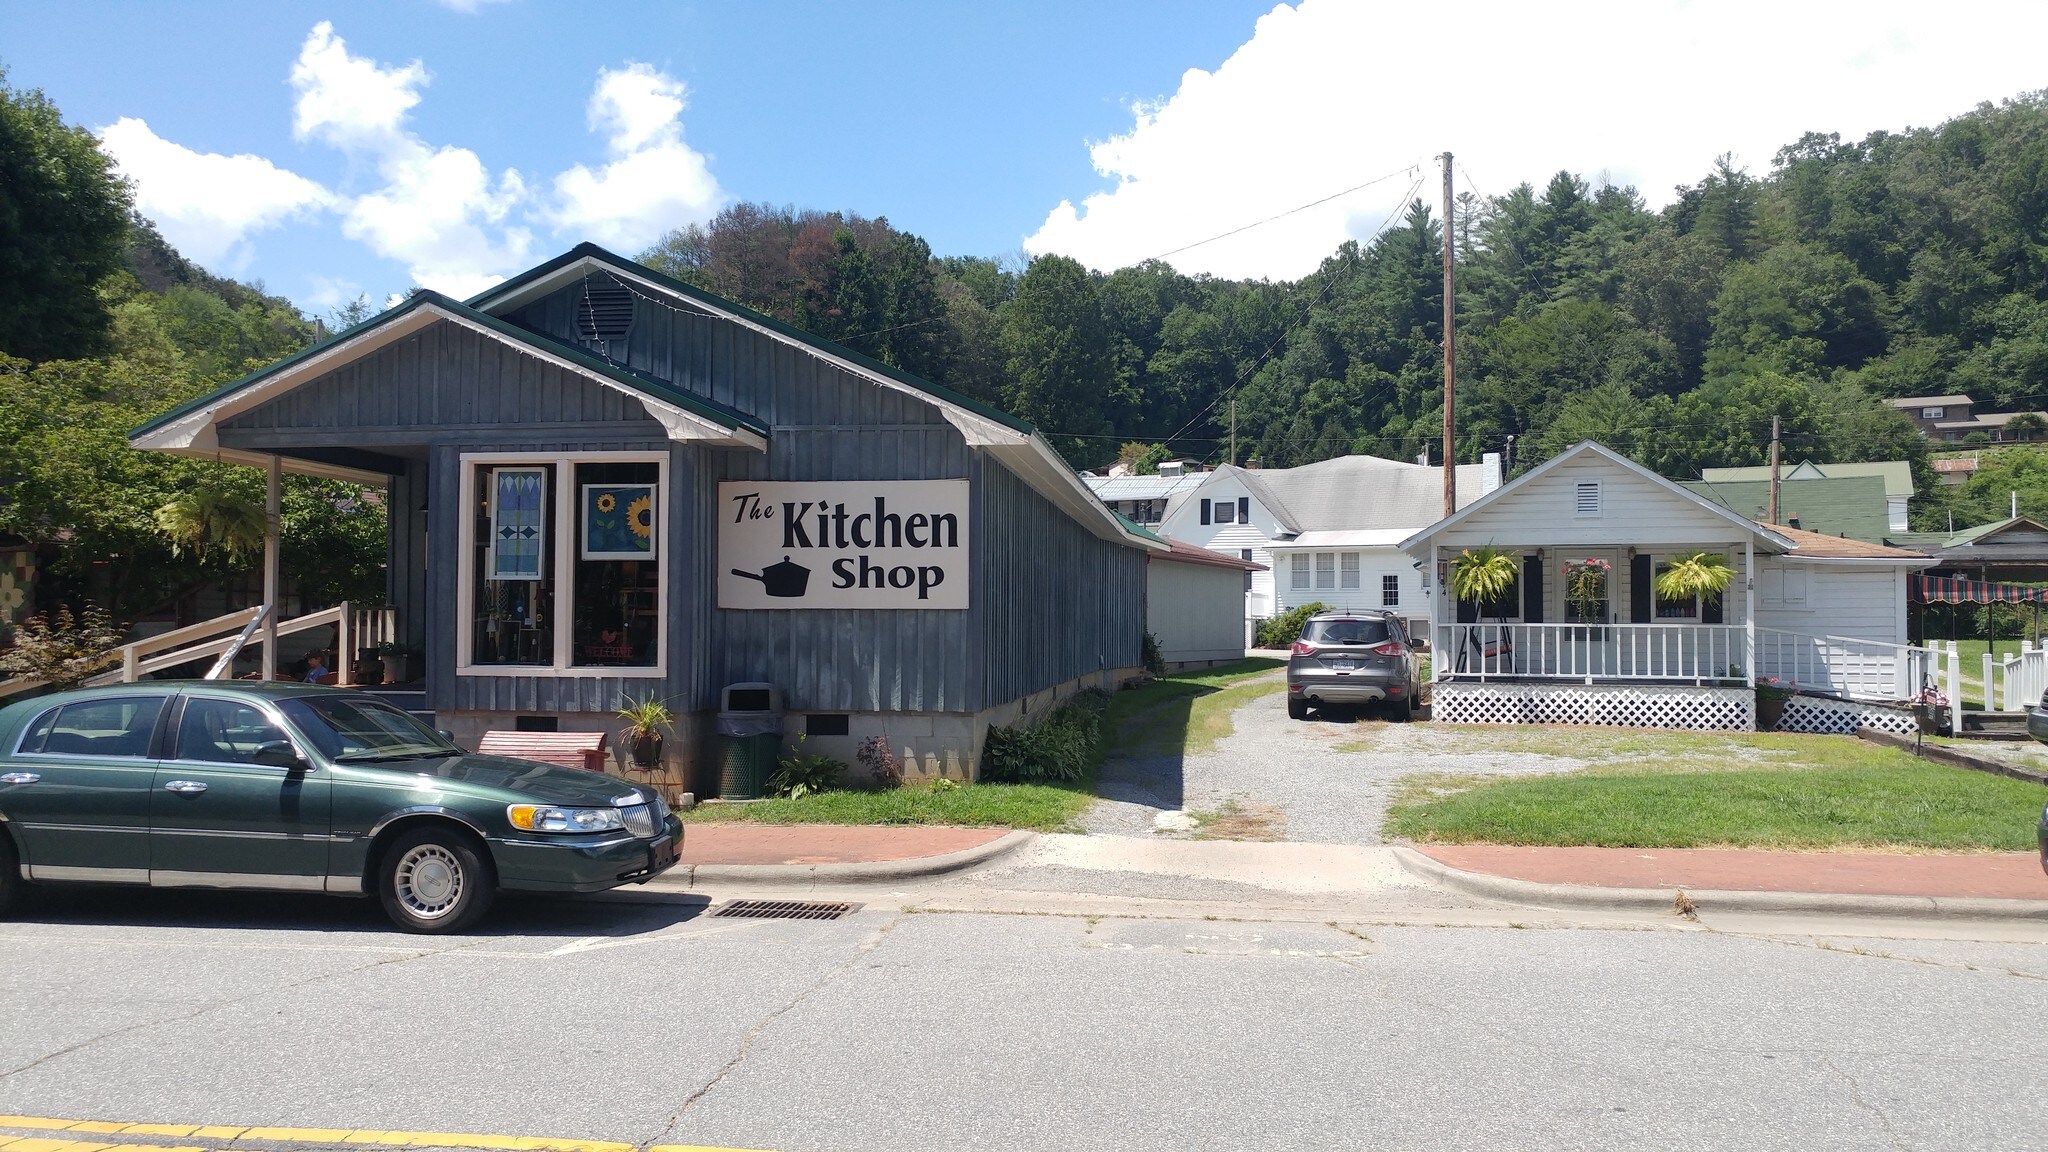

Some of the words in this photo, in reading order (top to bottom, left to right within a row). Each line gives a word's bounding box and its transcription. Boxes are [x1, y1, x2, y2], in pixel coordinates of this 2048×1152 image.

[732, 492, 775, 524] The
[782, 496, 959, 549] Kitchen
[832, 555, 945, 600] Shop
[585, 645, 633, 657] WELCOME
